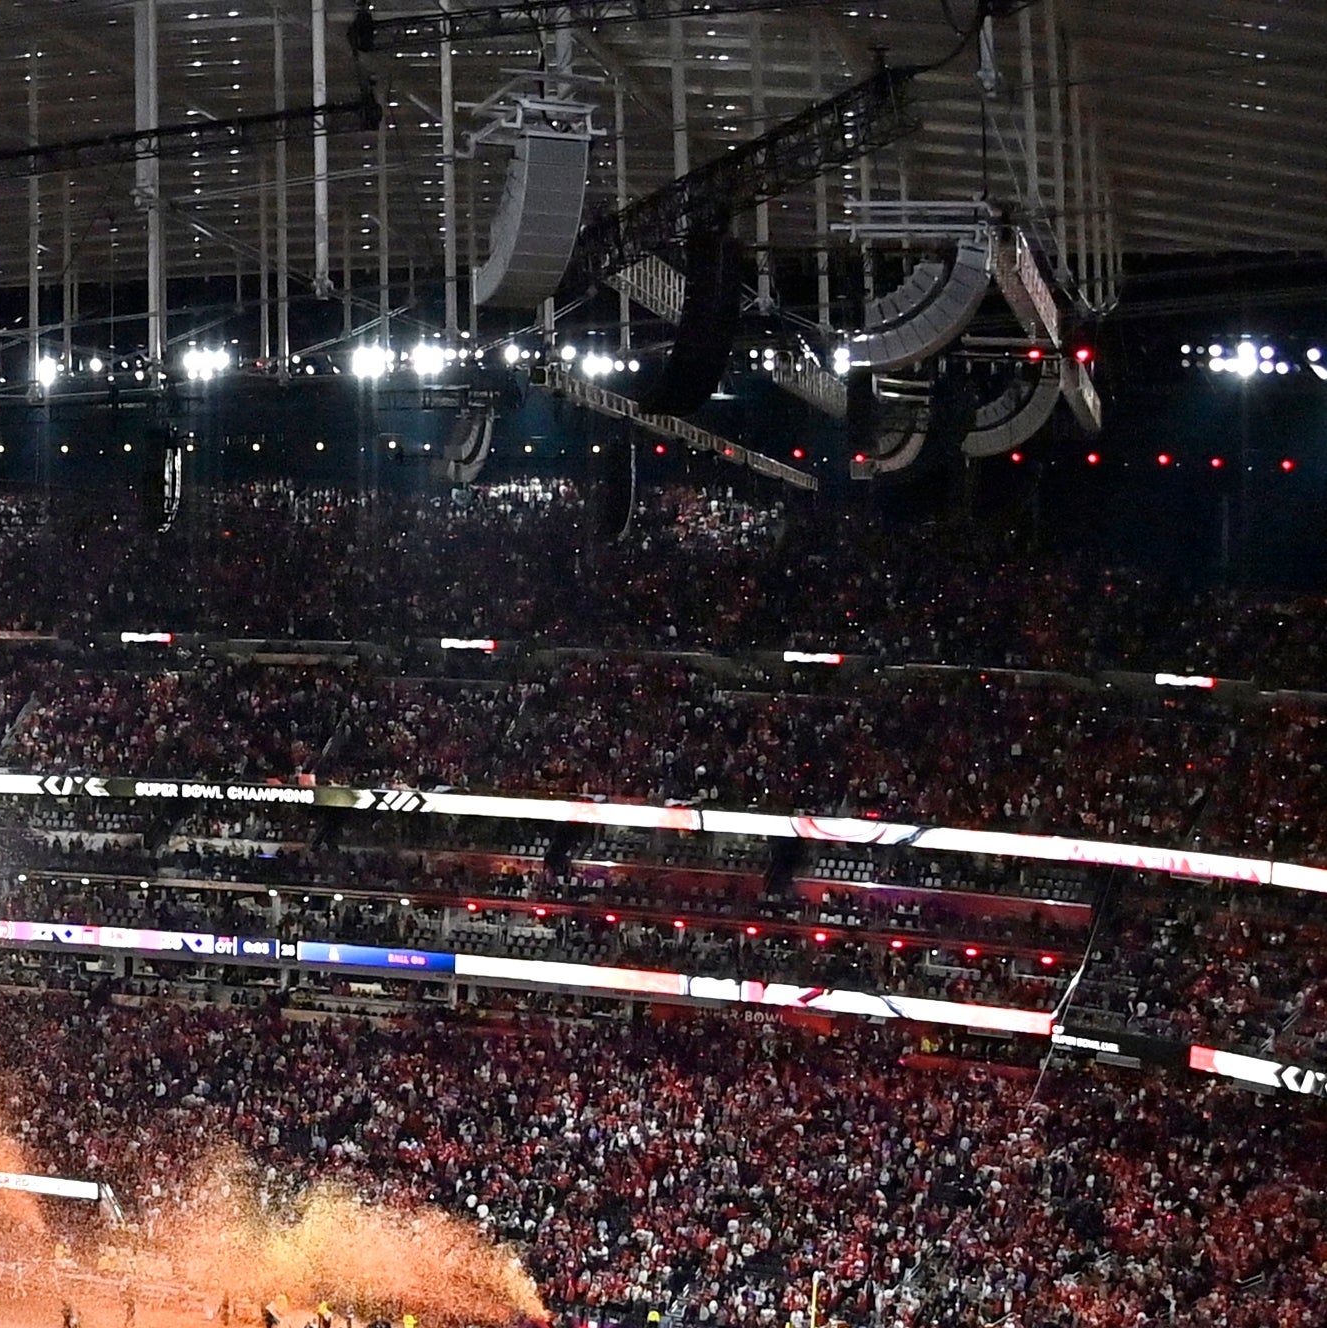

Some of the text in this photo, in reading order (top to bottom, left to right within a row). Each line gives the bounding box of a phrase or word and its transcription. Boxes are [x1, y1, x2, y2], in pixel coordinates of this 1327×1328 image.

[135, 782, 315, 804] SUPER BOWL CHAMPIONS
[745, 1010, 787, 1025] BOWL
